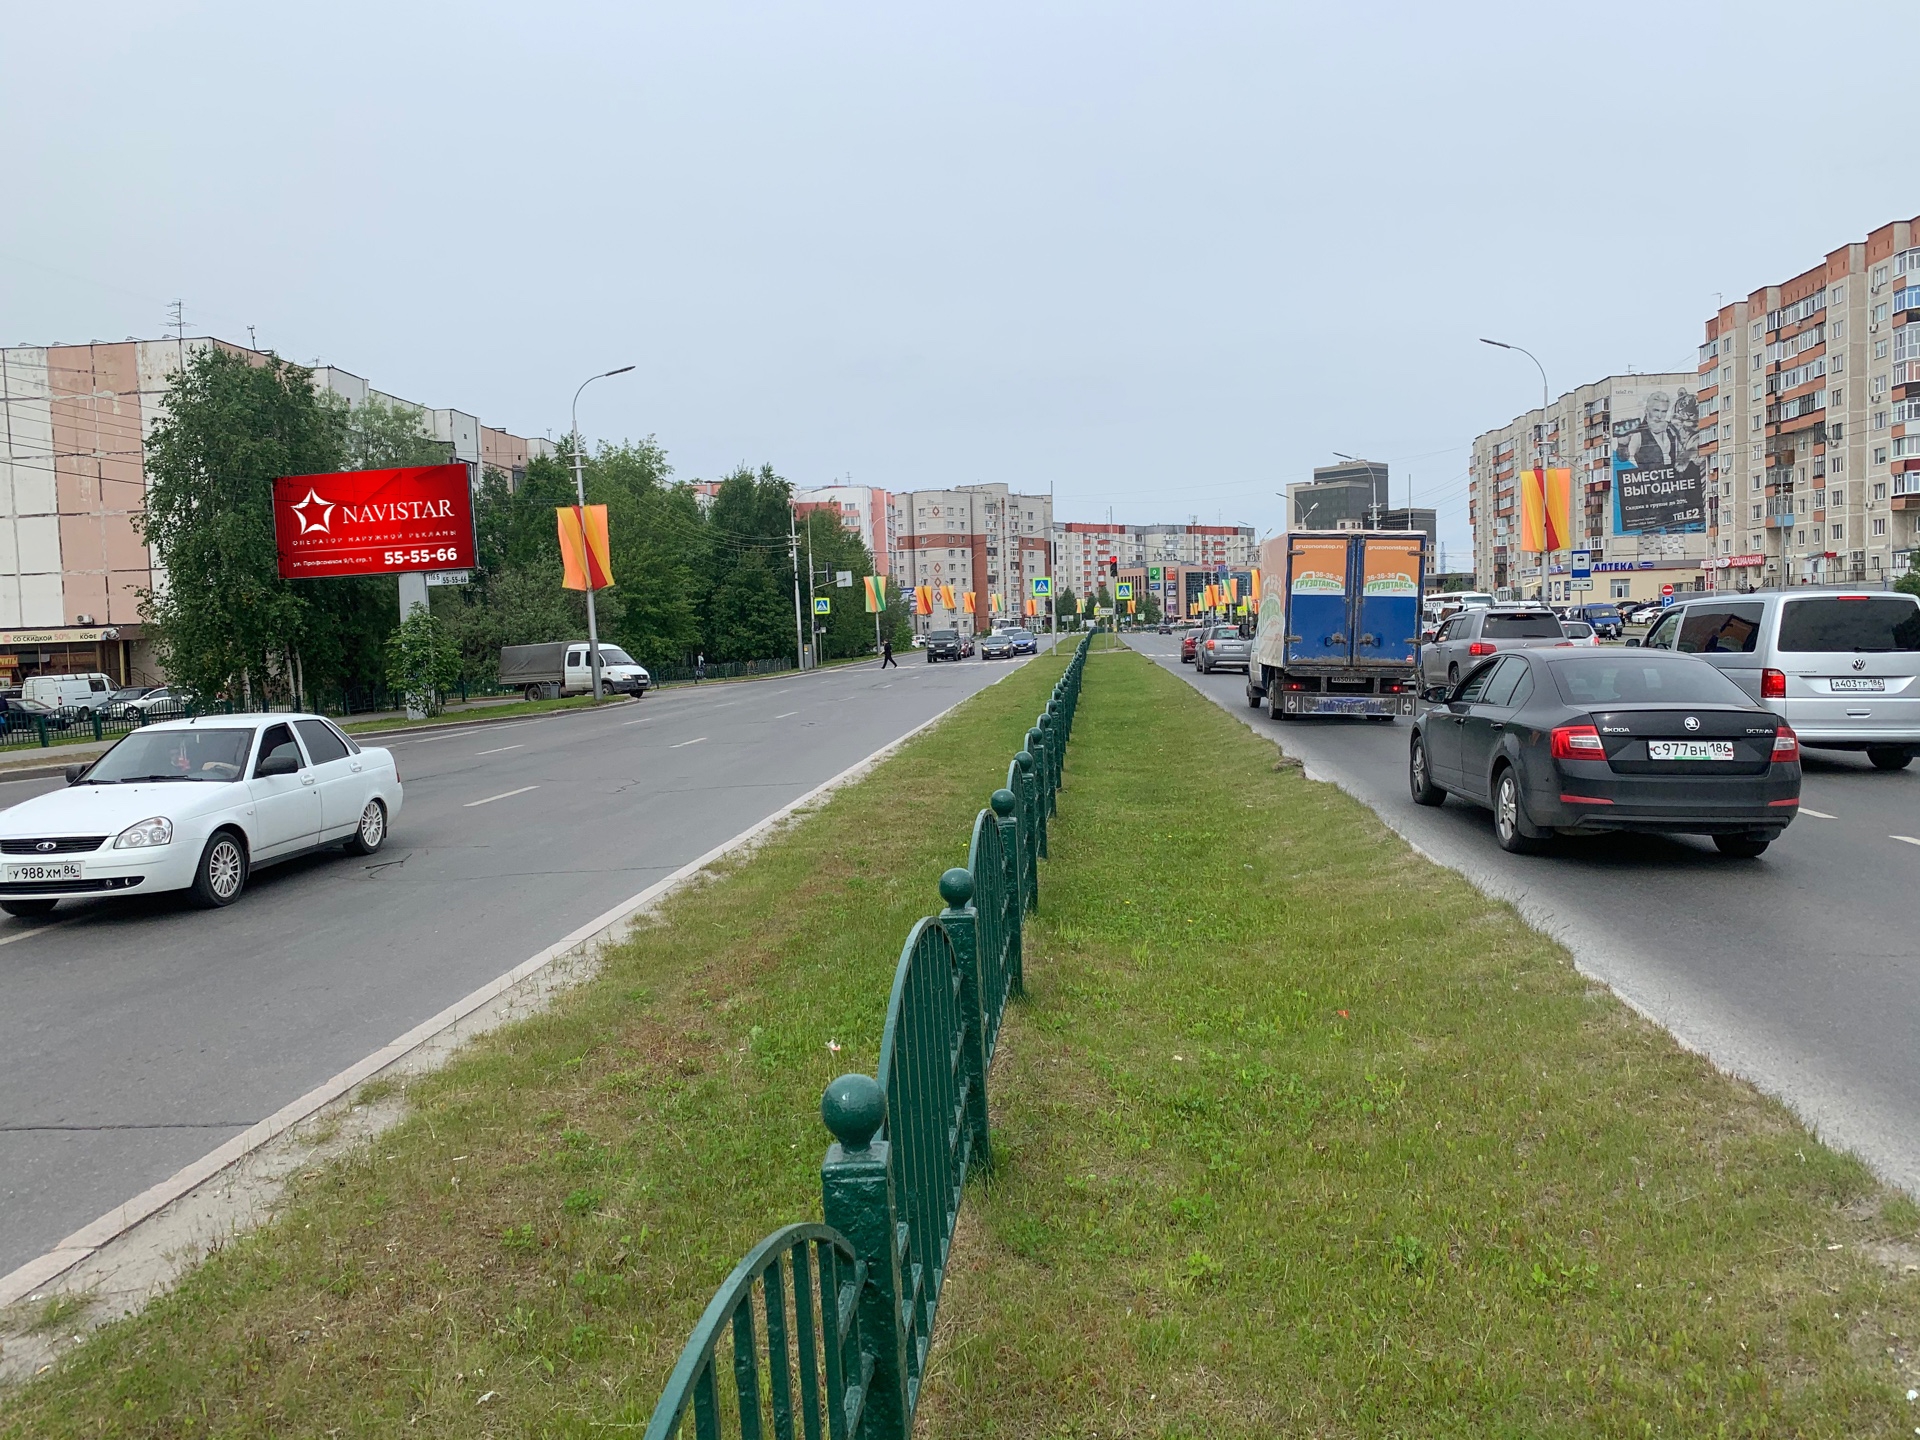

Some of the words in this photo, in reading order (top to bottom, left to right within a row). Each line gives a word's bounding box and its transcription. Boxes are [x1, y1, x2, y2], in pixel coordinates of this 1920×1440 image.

[1622, 468, 1675, 484] ВМЕСТЕ
[1623, 478, 1696, 497] ВЫГОДНЕЕ
[342, 499, 455, 524] NAVISTAR
[1672, 508, 1700, 521] TELE2
[292, 537, 343, 546] ОПЕРАТОР
[348, 532, 403, 542] НАРУЖНОЙ
[409, 530, 457, 539] РЕКЛАМЫ
[384, 547, 458, 565] 55-55-66
[1731, 555, 1762, 566] СОЦИАЛЬНАЯ
[1593, 562, 1634, 570] АПТЕКА
[442, 576, 467, 584] 55-55-66
[1295, 580, 1340, 590] ГРУЗОТАКСИ
[1367, 582, 1413, 593] ГРУЗОТАКСИ
[54, 633, 71, 641] 50%
[1710, 743, 1729, 752] 186
[64, 865, 76, 874] 86
